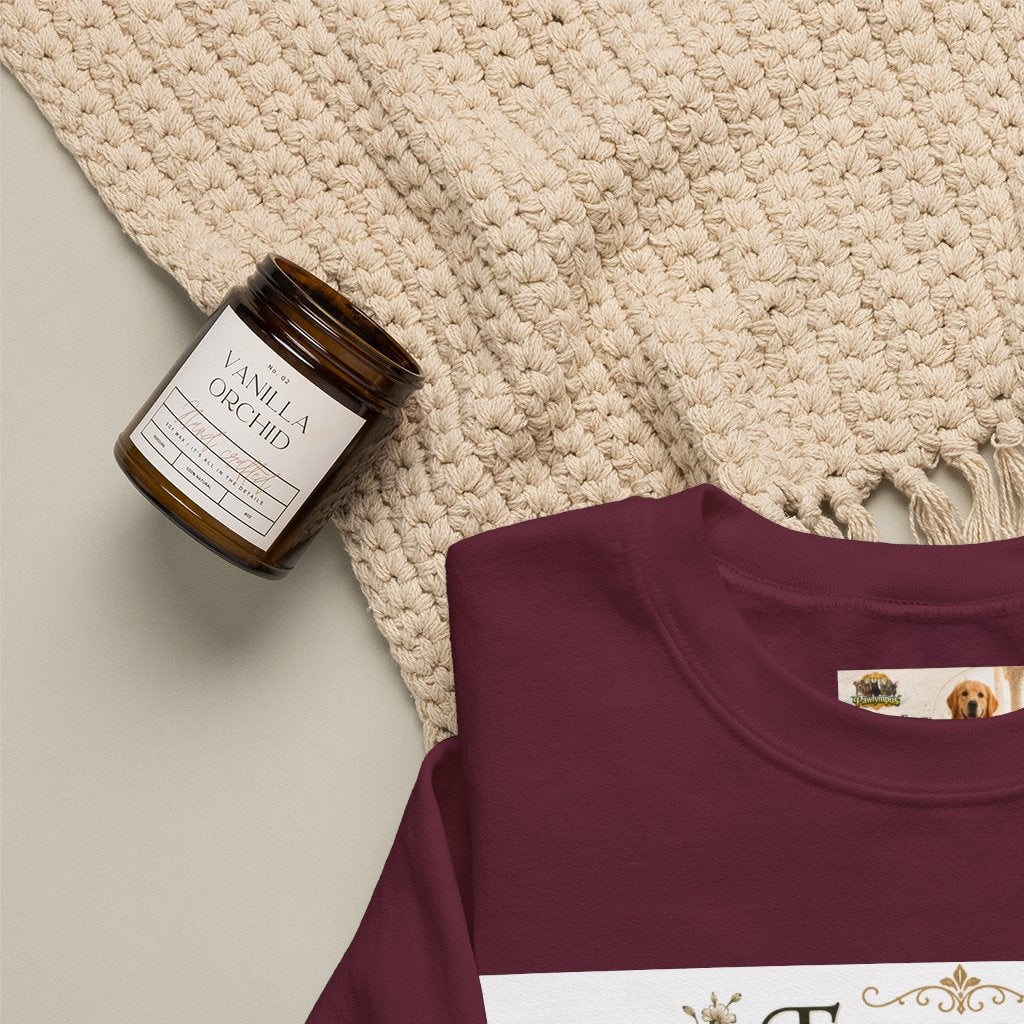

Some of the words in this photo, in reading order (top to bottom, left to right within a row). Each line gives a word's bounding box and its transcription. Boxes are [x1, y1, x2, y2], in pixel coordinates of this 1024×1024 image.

[224, 349, 309, 434] VANILLA
[267, 364, 278, 376] No.
[280, 375, 291, 385] 02
[209, 377, 290, 450] ORCHID
[203, 458, 214, 468] ALL
[225, 475, 237, 486] THE
[238, 485, 264, 505] DETAILS
